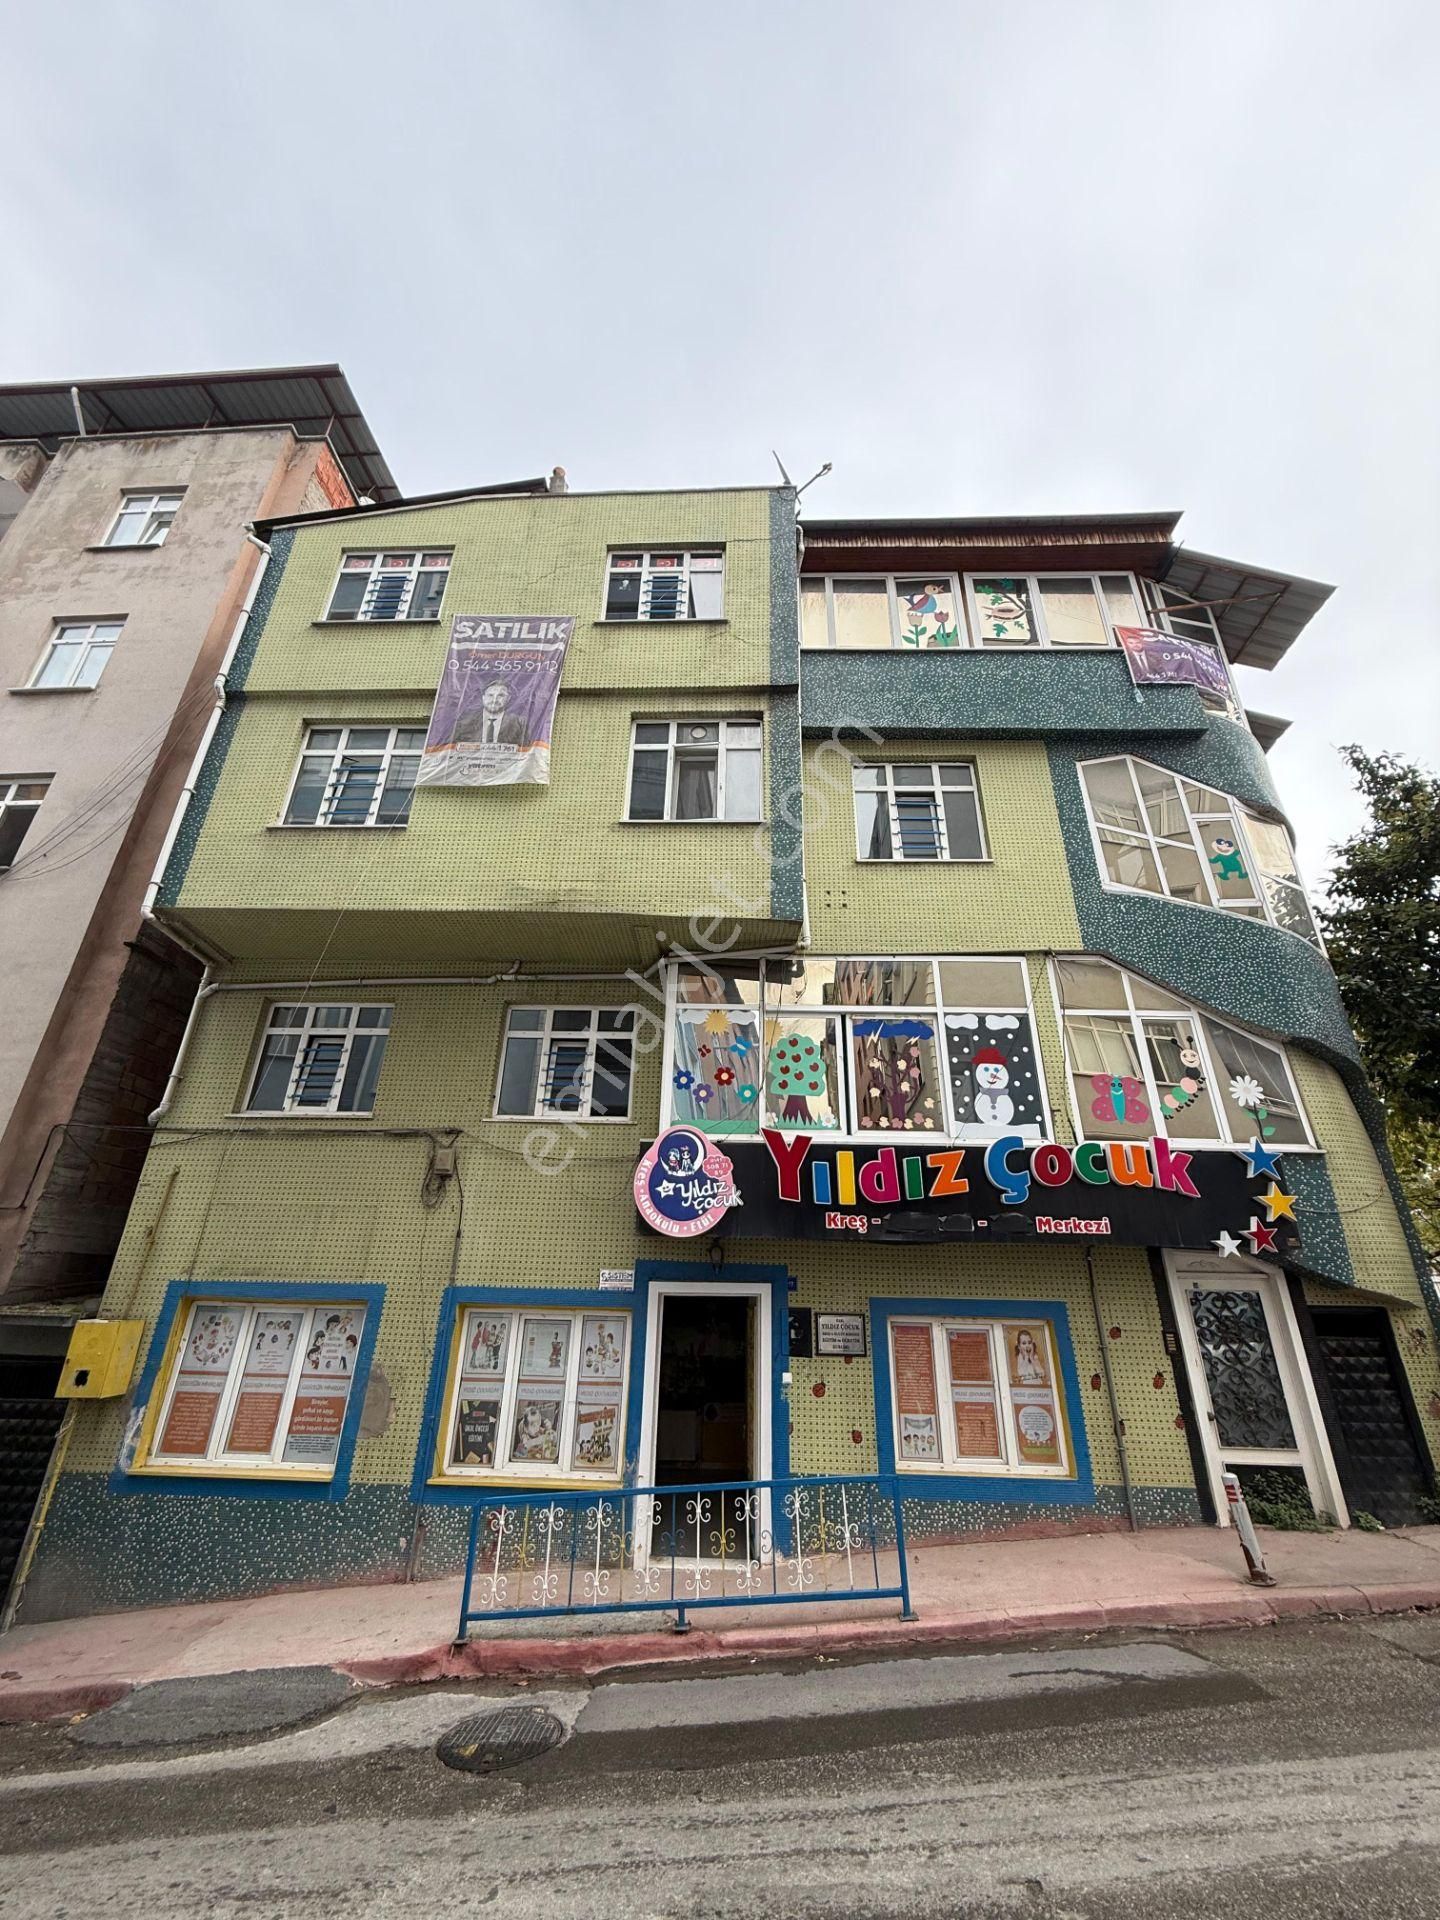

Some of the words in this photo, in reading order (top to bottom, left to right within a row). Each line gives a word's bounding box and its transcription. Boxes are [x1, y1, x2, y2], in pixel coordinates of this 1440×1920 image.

[454, 621, 569, 639] SATILIK
[463, 660, 490, 671] 544
[493, 660, 522, 671] 565
[635, 1158, 653, 1186] Kreş
[761, 1127, 970, 1205] Yıldız
[984, 1135, 1201, 1205] Çocuk
[639, 1194, 681, 1233] Anaokulu
[690, 1213, 714, 1231] Etüt
[825, 1211, 868, 1234] Kreş
[1036, 1216, 1111, 1236] Merkezi
